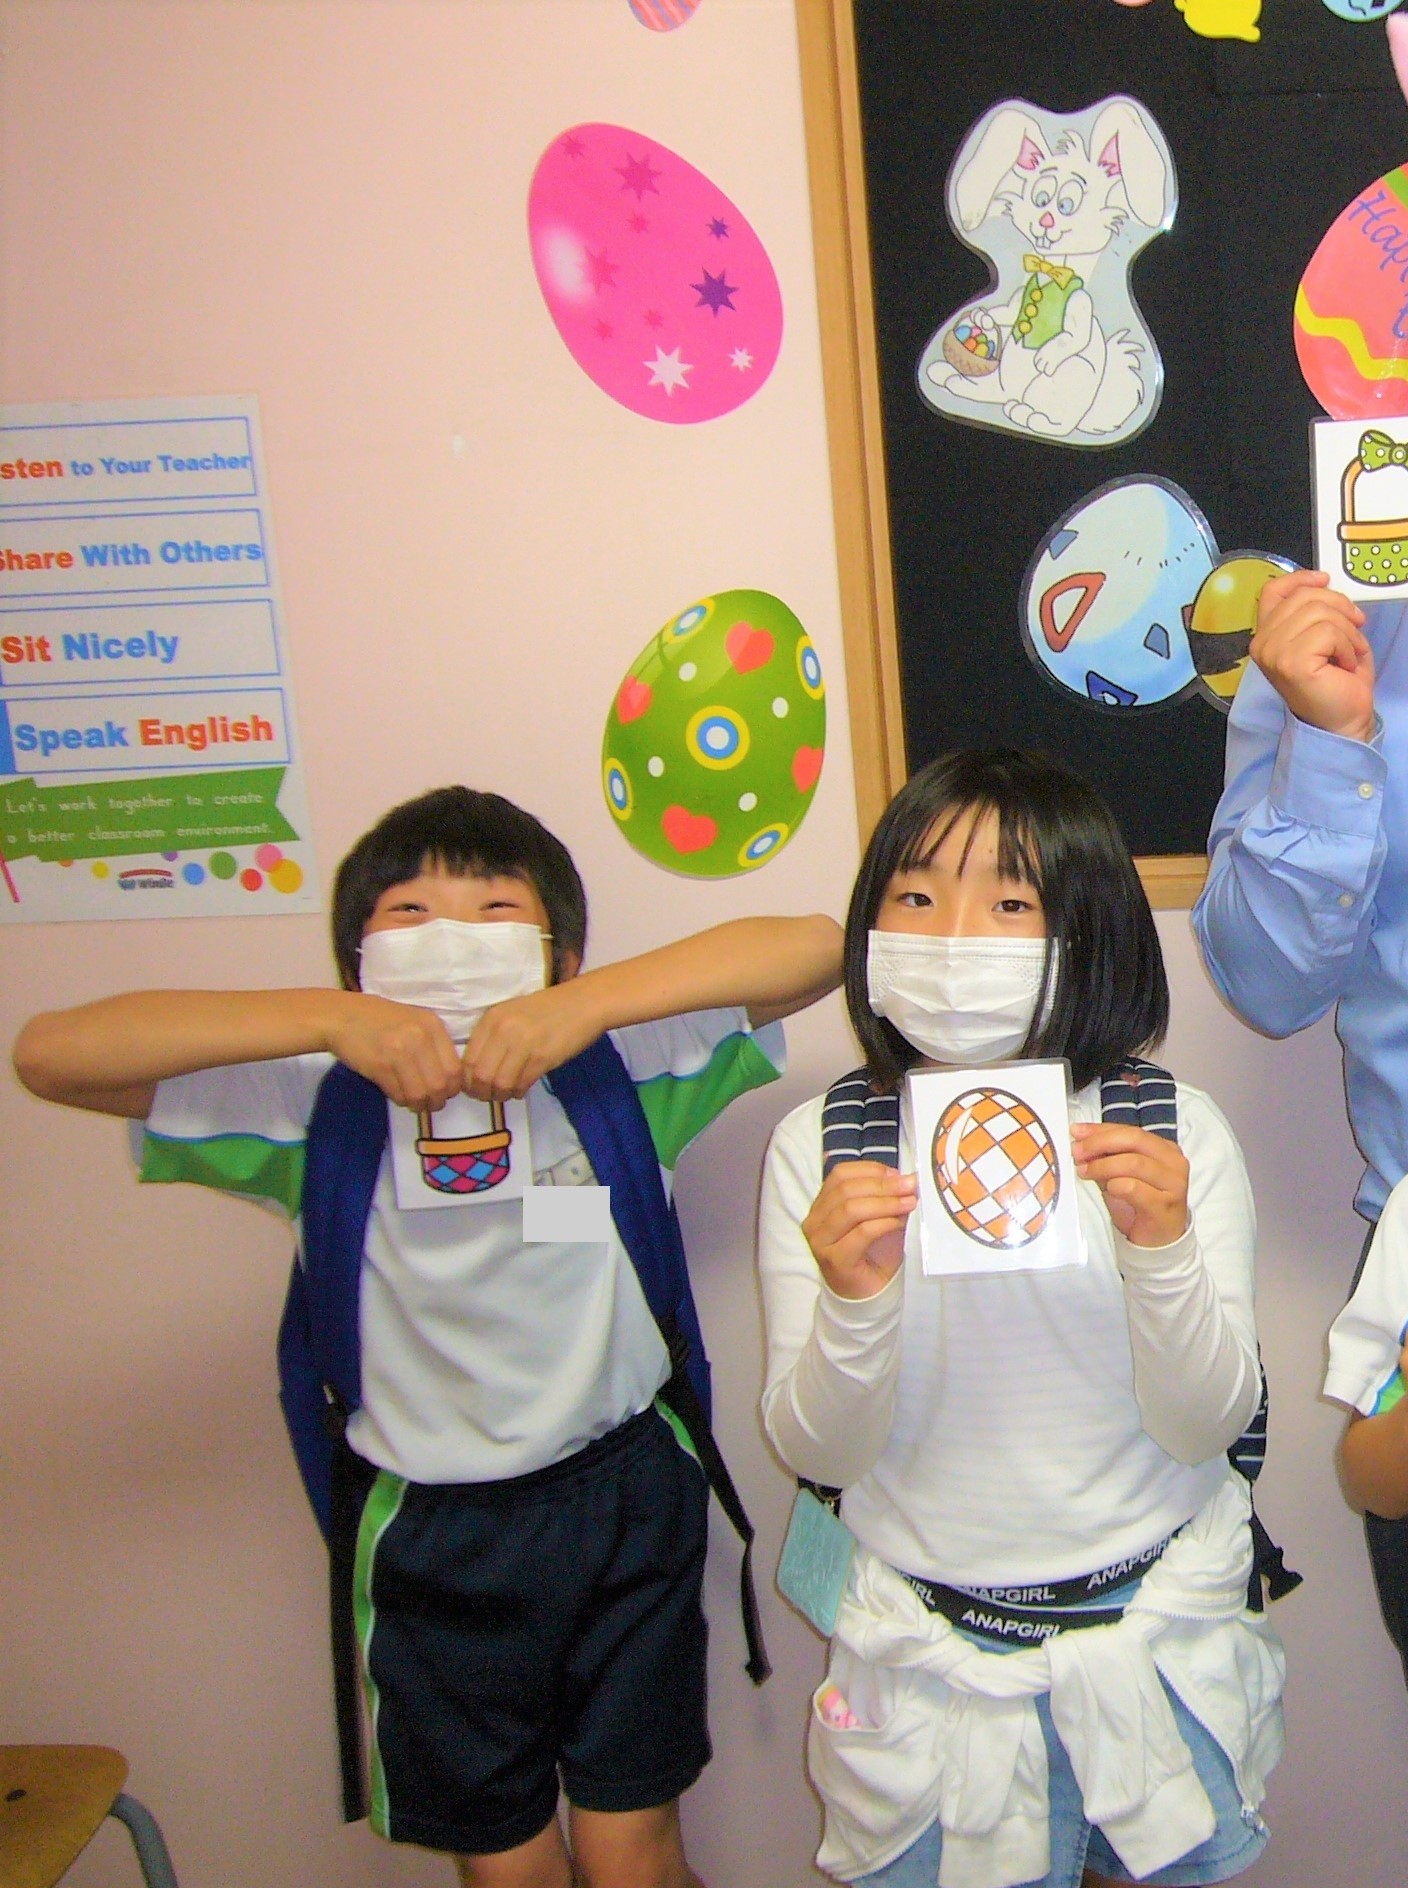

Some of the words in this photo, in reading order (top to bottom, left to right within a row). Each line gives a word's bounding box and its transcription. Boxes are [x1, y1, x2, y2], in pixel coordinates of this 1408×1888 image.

[0, 457, 64, 480] sten
[70, 459, 94, 476] to
[99, 456, 151, 475] Your
[156, 452, 250, 473] Teacher
[80, 543, 151, 568] With
[159, 540, 264, 565] Others
[1, 635, 51, 664] Sit
[61, 629, 178, 664] Nicely
[14, 720, 130, 757] Speak
[138, 714, 274, 751] English
[5, 797, 47, 814] Let's
[58, 795, 97, 811] work
[108, 793, 173, 816] together
[185, 794, 204, 806] to
[213, 792, 263, 805] create
[26, 828, 75, 843] better
[88, 825, 166, 840] classroom
